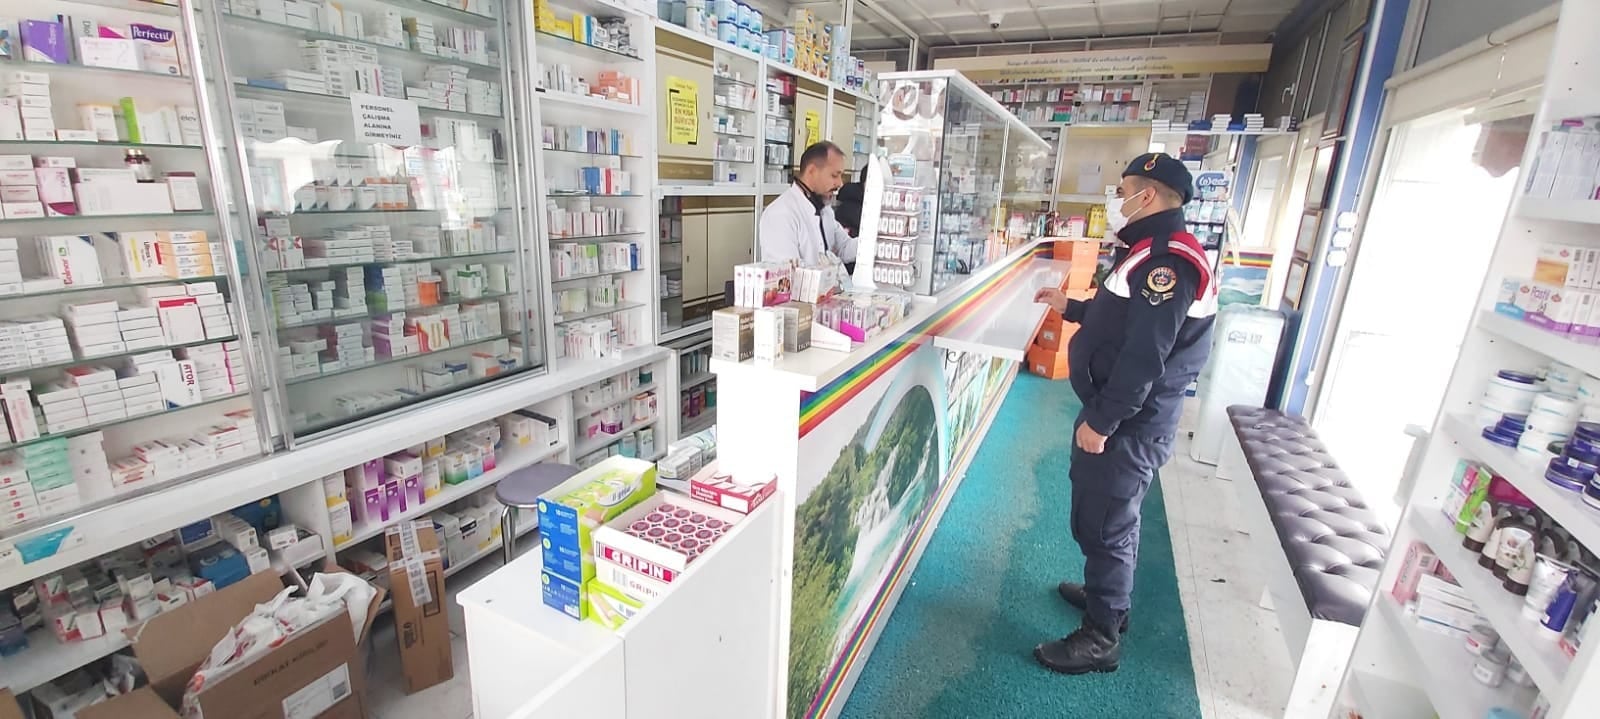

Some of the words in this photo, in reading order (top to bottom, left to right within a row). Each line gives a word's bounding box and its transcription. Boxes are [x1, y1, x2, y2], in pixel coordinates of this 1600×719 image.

[132, 25, 170, 41] Perfectil
[360, 104, 394, 113] PERSONEL
[362, 113, 391, 121] ÇALIŞMA
[363, 122, 392, 130] ALANINA
[183, 363, 195, 386] ATOR
[611, 548, 664, 580] GRIPIN
